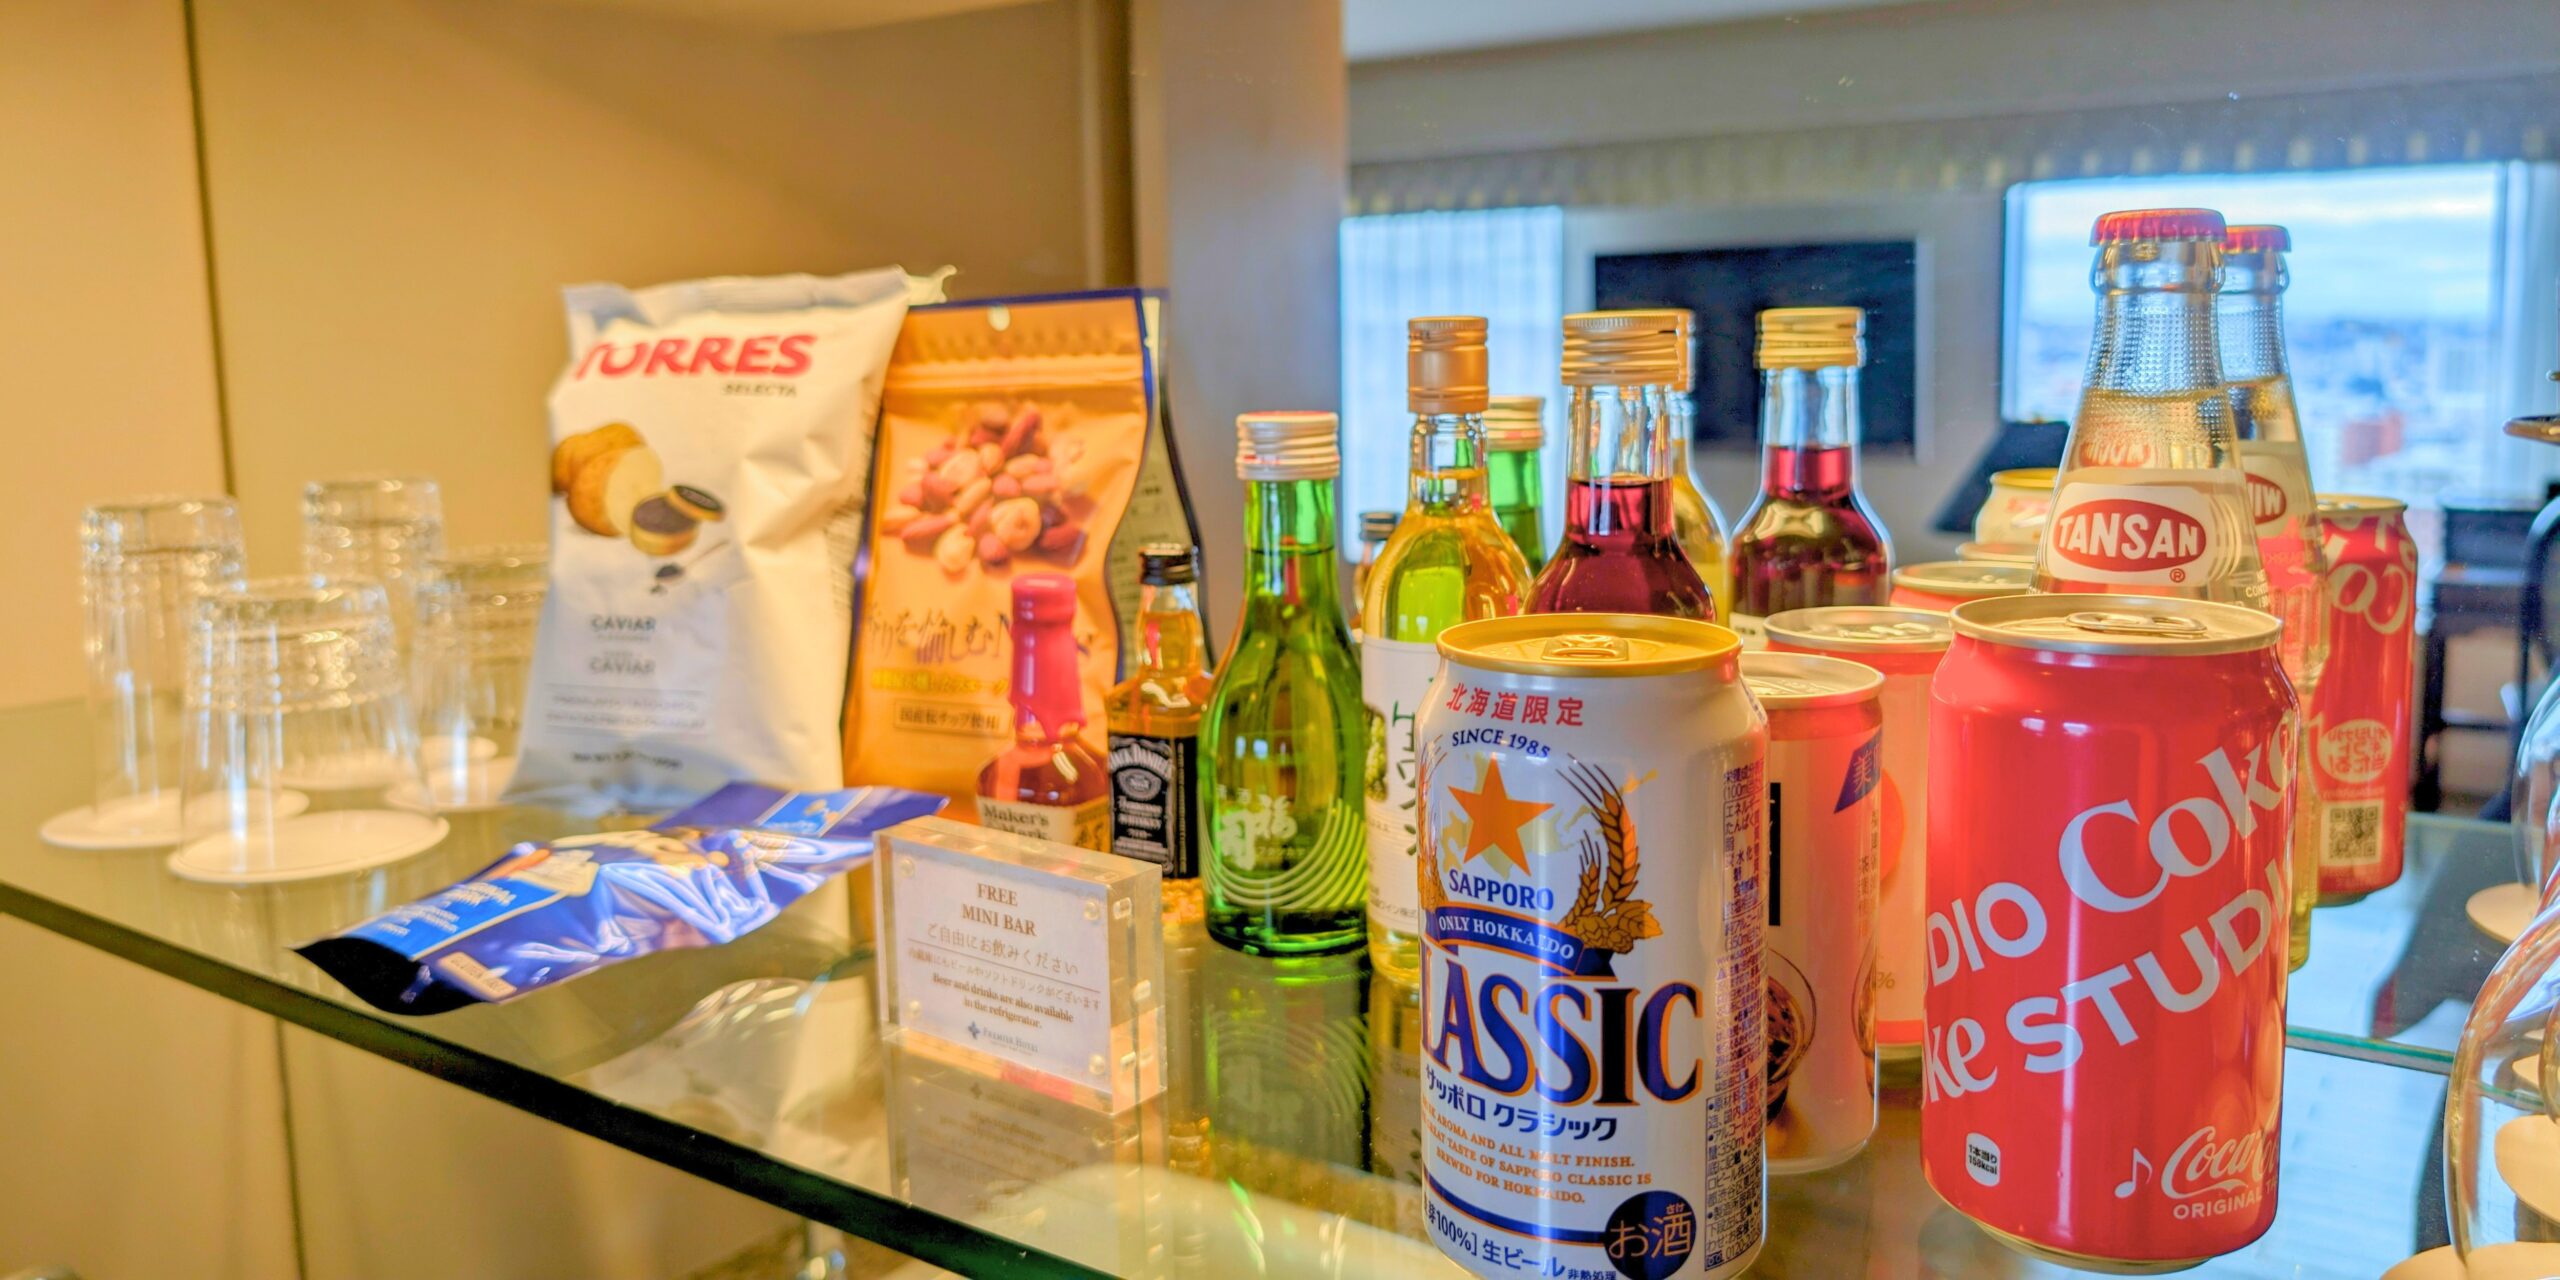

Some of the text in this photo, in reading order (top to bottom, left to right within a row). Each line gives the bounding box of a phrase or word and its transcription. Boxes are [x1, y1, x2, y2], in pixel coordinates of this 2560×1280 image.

[574, 334, 818, 381] TORRES
[722, 384, 798, 398] SELECTA
[2058, 511, 2201, 561] TANSAN
[590, 615, 657, 632] CAVIAR
[589, 657, 656, 675] CAVIAR
[1446, 682, 1584, 727] 北海道限定
[1451, 727, 1551, 759] SINCE 1985
[983, 803, 1049, 827] Maker's
[2058, 706, 2295, 913] Coke
[976, 882, 1019, 907] FREE
[1449, 868, 1555, 911] SAPPORO
[962, 904, 1038, 937] MINI BAR
[1438, 914, 1575, 960] ONLY HOKKAIDO
[926, 922, 1079, 976] ご自由にお飲みください
[933, 972, 1074, 1024] Beer and drinks are also available
[974, 999, 988, 1012] the
[989, 1005, 1043, 1029] refrigerator.
[1425, 1064, 1486, 1121] サッポロ
[1493, 1102, 1618, 1142] クラシック
[1448, 1138, 1477, 1162] TASTE
[1480, 1154, 1496, 1168] OF
[1499, 1160, 1563, 1183] SAPPORO
[1567, 1173, 1633, 1186] CLASSIC
[1637, 1172, 1653, 1185] IS
[1471, 1132, 1496, 1151] AND
[1500, 1143, 1525, 1159] ALL
[1529, 1149, 1571, 1166] MALT
[1575, 1155, 1636, 1168] FINISH.
[1436, 1146, 1586, 1204] BREWED FOR HOKKAIDO.
[1666, 1202, 1685, 1214] さけ
[2173, 1188, 2264, 1220] ORIGINAL
[1608, 1211, 1692, 1259] お酒
[1482, 1239, 1566, 1277] 生ビール
